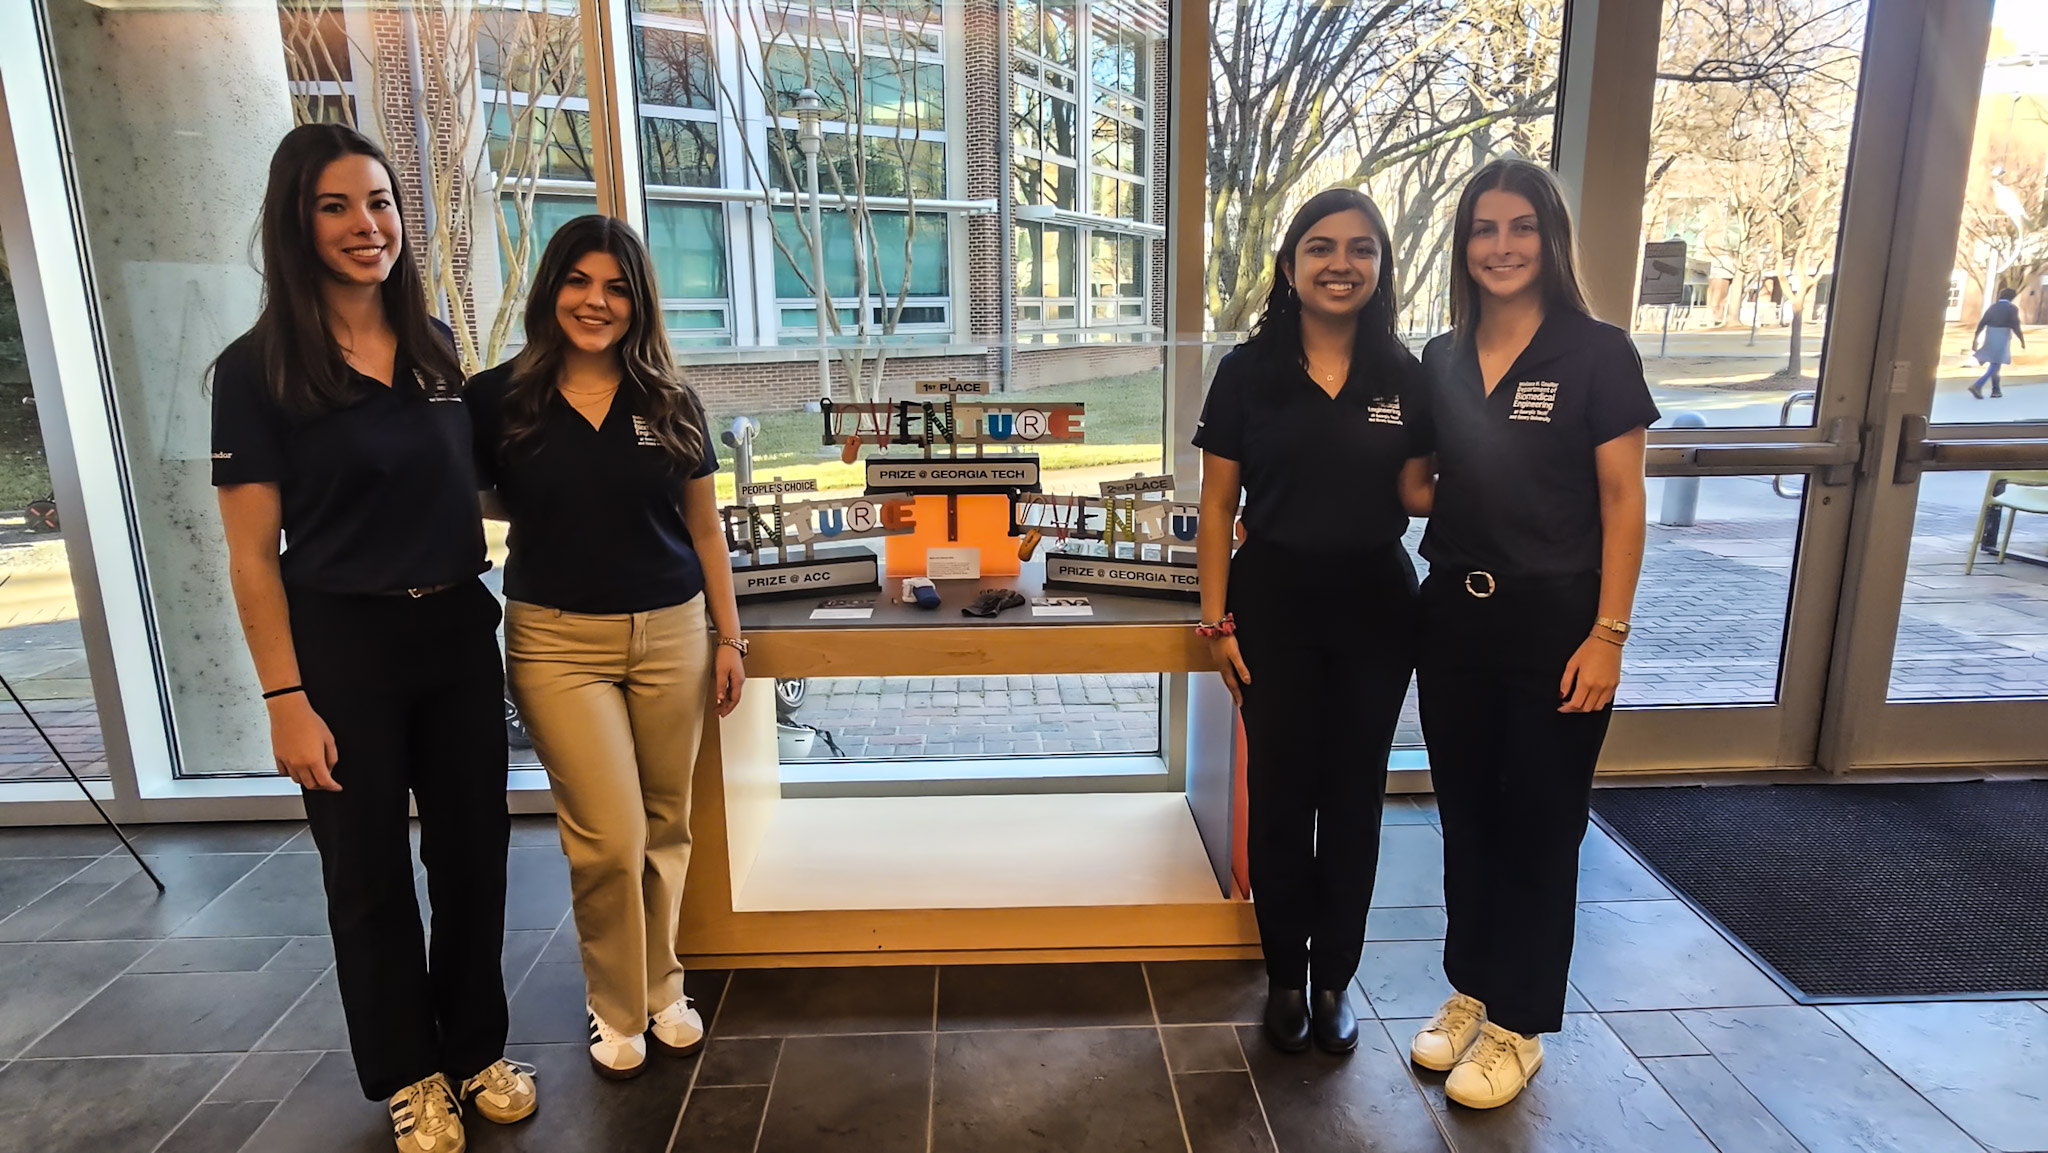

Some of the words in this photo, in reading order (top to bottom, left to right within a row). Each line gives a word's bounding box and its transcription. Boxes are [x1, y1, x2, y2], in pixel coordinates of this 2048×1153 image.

[939, 383, 981, 392] PLACE
[1515, 393, 1556, 402] Biomedical
[1512, 400, 1554, 411] Engineering
[879, 470, 916, 479] PRIZE
[918, 470, 927, 479] @
[930, 470, 988, 479] GEORGIA
[990, 470, 1025, 479] TECH
[742, 484, 783, 495] PEOPLE'S
[784, 481, 815, 492] CHOICE
[1125, 479, 1169, 491] PLACE
[722, 499, 917, 554] ENTURE
[748, 575, 787, 587] PRIZE
[789, 574, 800, 584] @
[803, 571, 831, 582] ACC
[1059, 565, 1094, 577] PRIZE
[1097, 568, 1106, 578] @
[1108, 569, 1168, 583] GEORGIA
